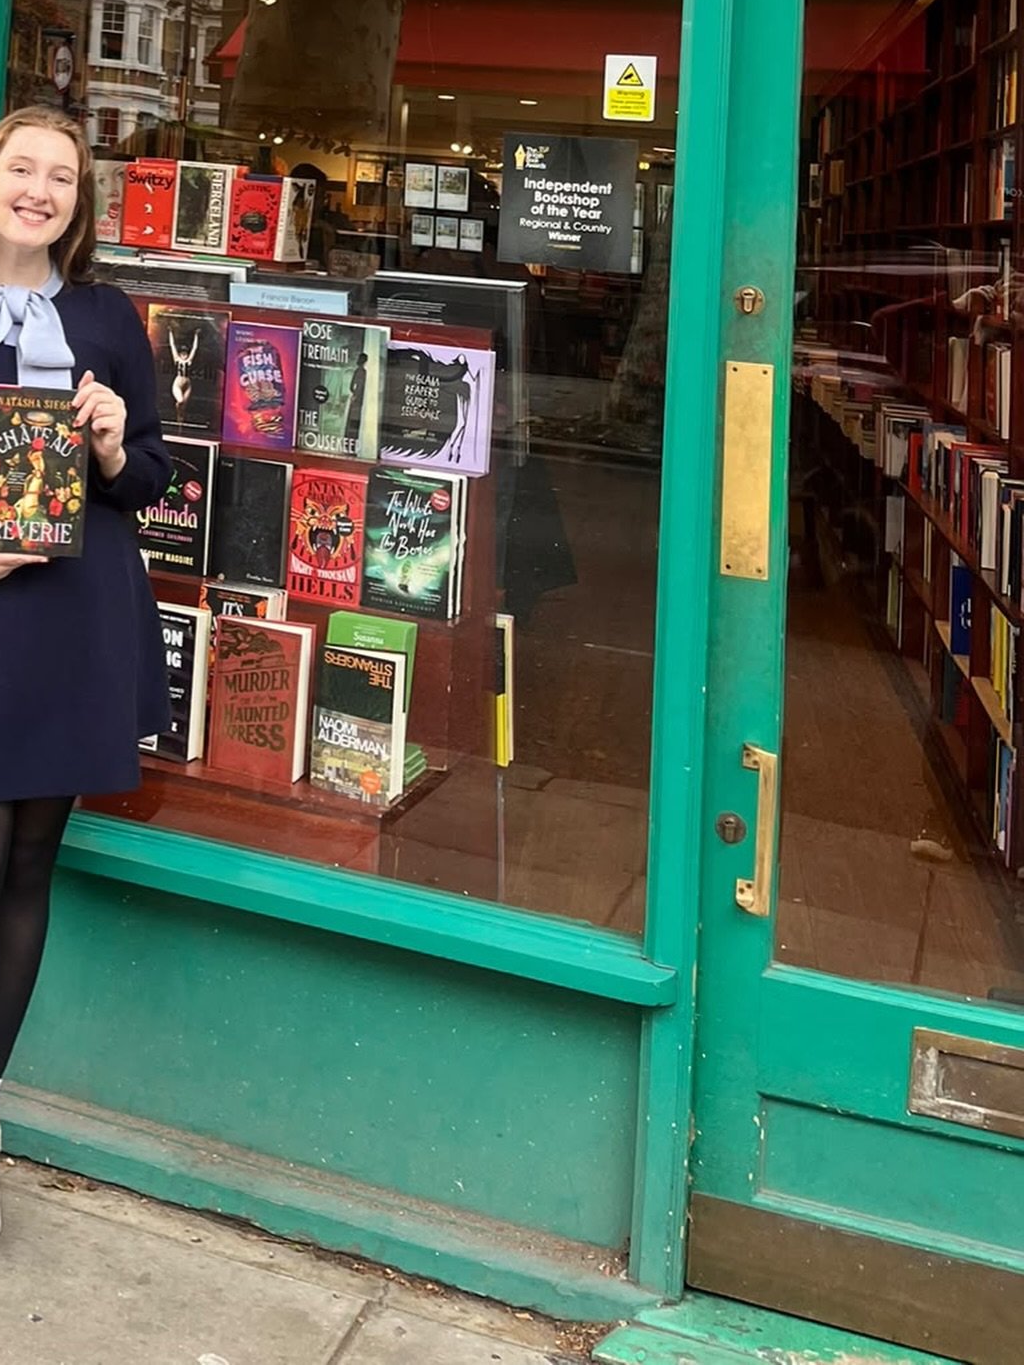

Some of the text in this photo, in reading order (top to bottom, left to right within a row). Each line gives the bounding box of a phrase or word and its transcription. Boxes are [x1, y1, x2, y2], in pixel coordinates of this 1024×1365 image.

[128, 170, 174, 190] Switzy
[524, 177, 612, 194] Independent
[207, 170, 224, 246] FIERCELAND
[534, 190, 600, 208] Bookshop
[530, 203, 602, 219] of the Year
[519, 217, 612, 234] Regional & Country
[303, 322, 332, 340] ROSE
[243, 353, 273, 367] FISH
[303, 343, 349, 364] TREMAIN
[240, 369, 282, 387] CURSE
[43, 399, 74, 411] SIEGE
[299, 409, 318, 427] THE
[291, 575, 354, 600] HELLS
[162, 628, 183, 647] ON
[353, 631, 384, 645] Susanna
[324, 651, 393, 677] STRANGERS
[223, 669, 290, 693] MURDER
[368, 673, 392, 690] THE
[223, 700, 290, 725] HAUNTED
[318, 715, 358, 736] NAOMI
